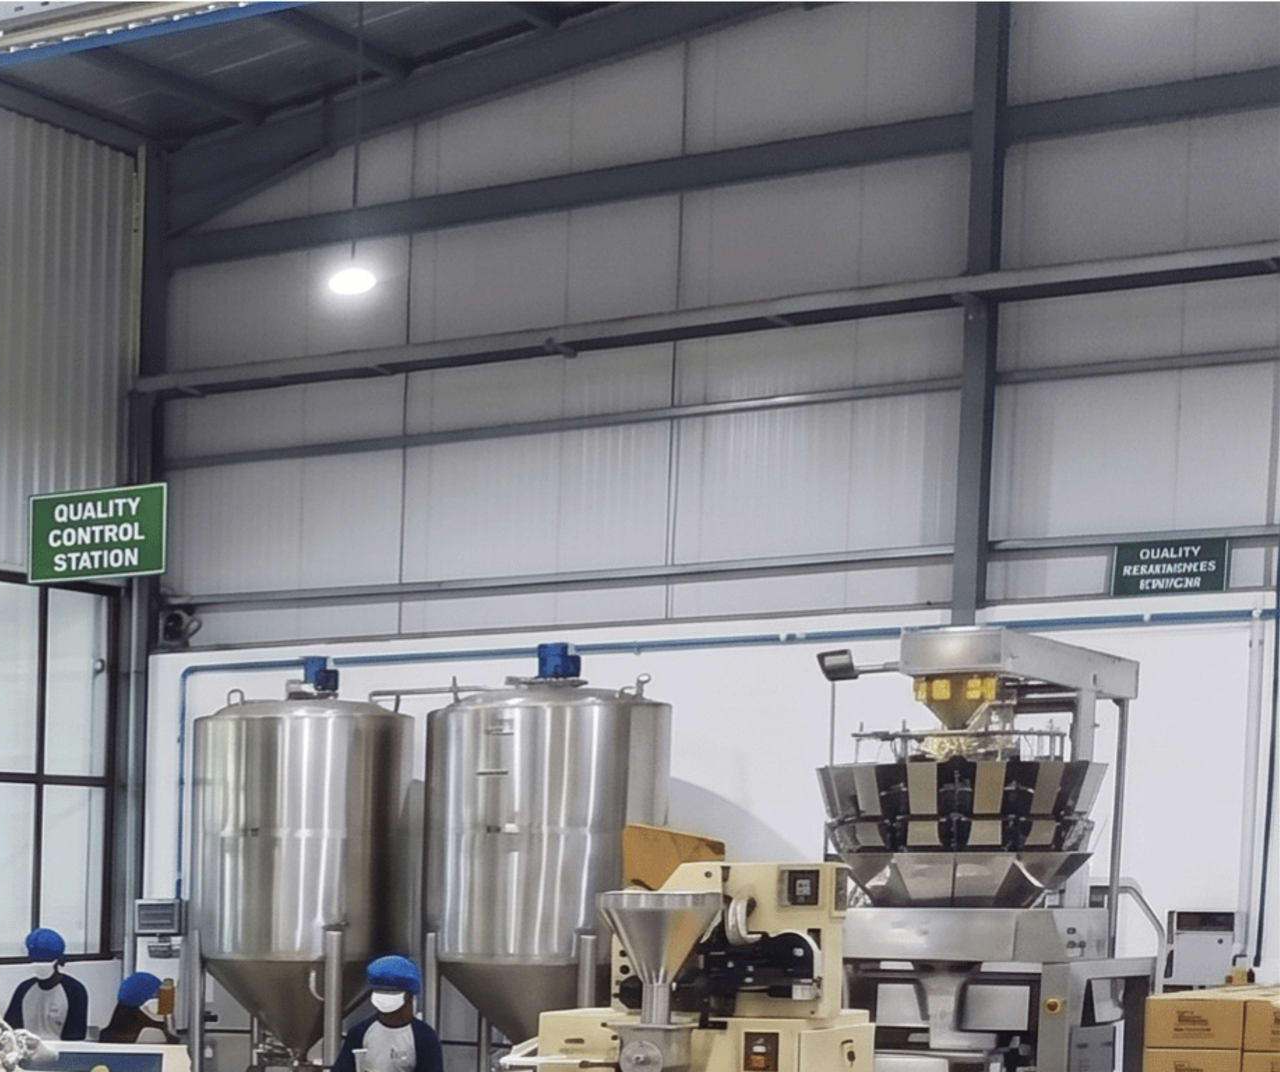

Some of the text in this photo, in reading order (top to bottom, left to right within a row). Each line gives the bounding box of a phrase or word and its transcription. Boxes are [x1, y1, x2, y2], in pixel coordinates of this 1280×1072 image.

[54, 497, 141, 523] QUALITY
[48, 522, 145, 547] CONTROL
[53, 548, 139, 572] STATION
